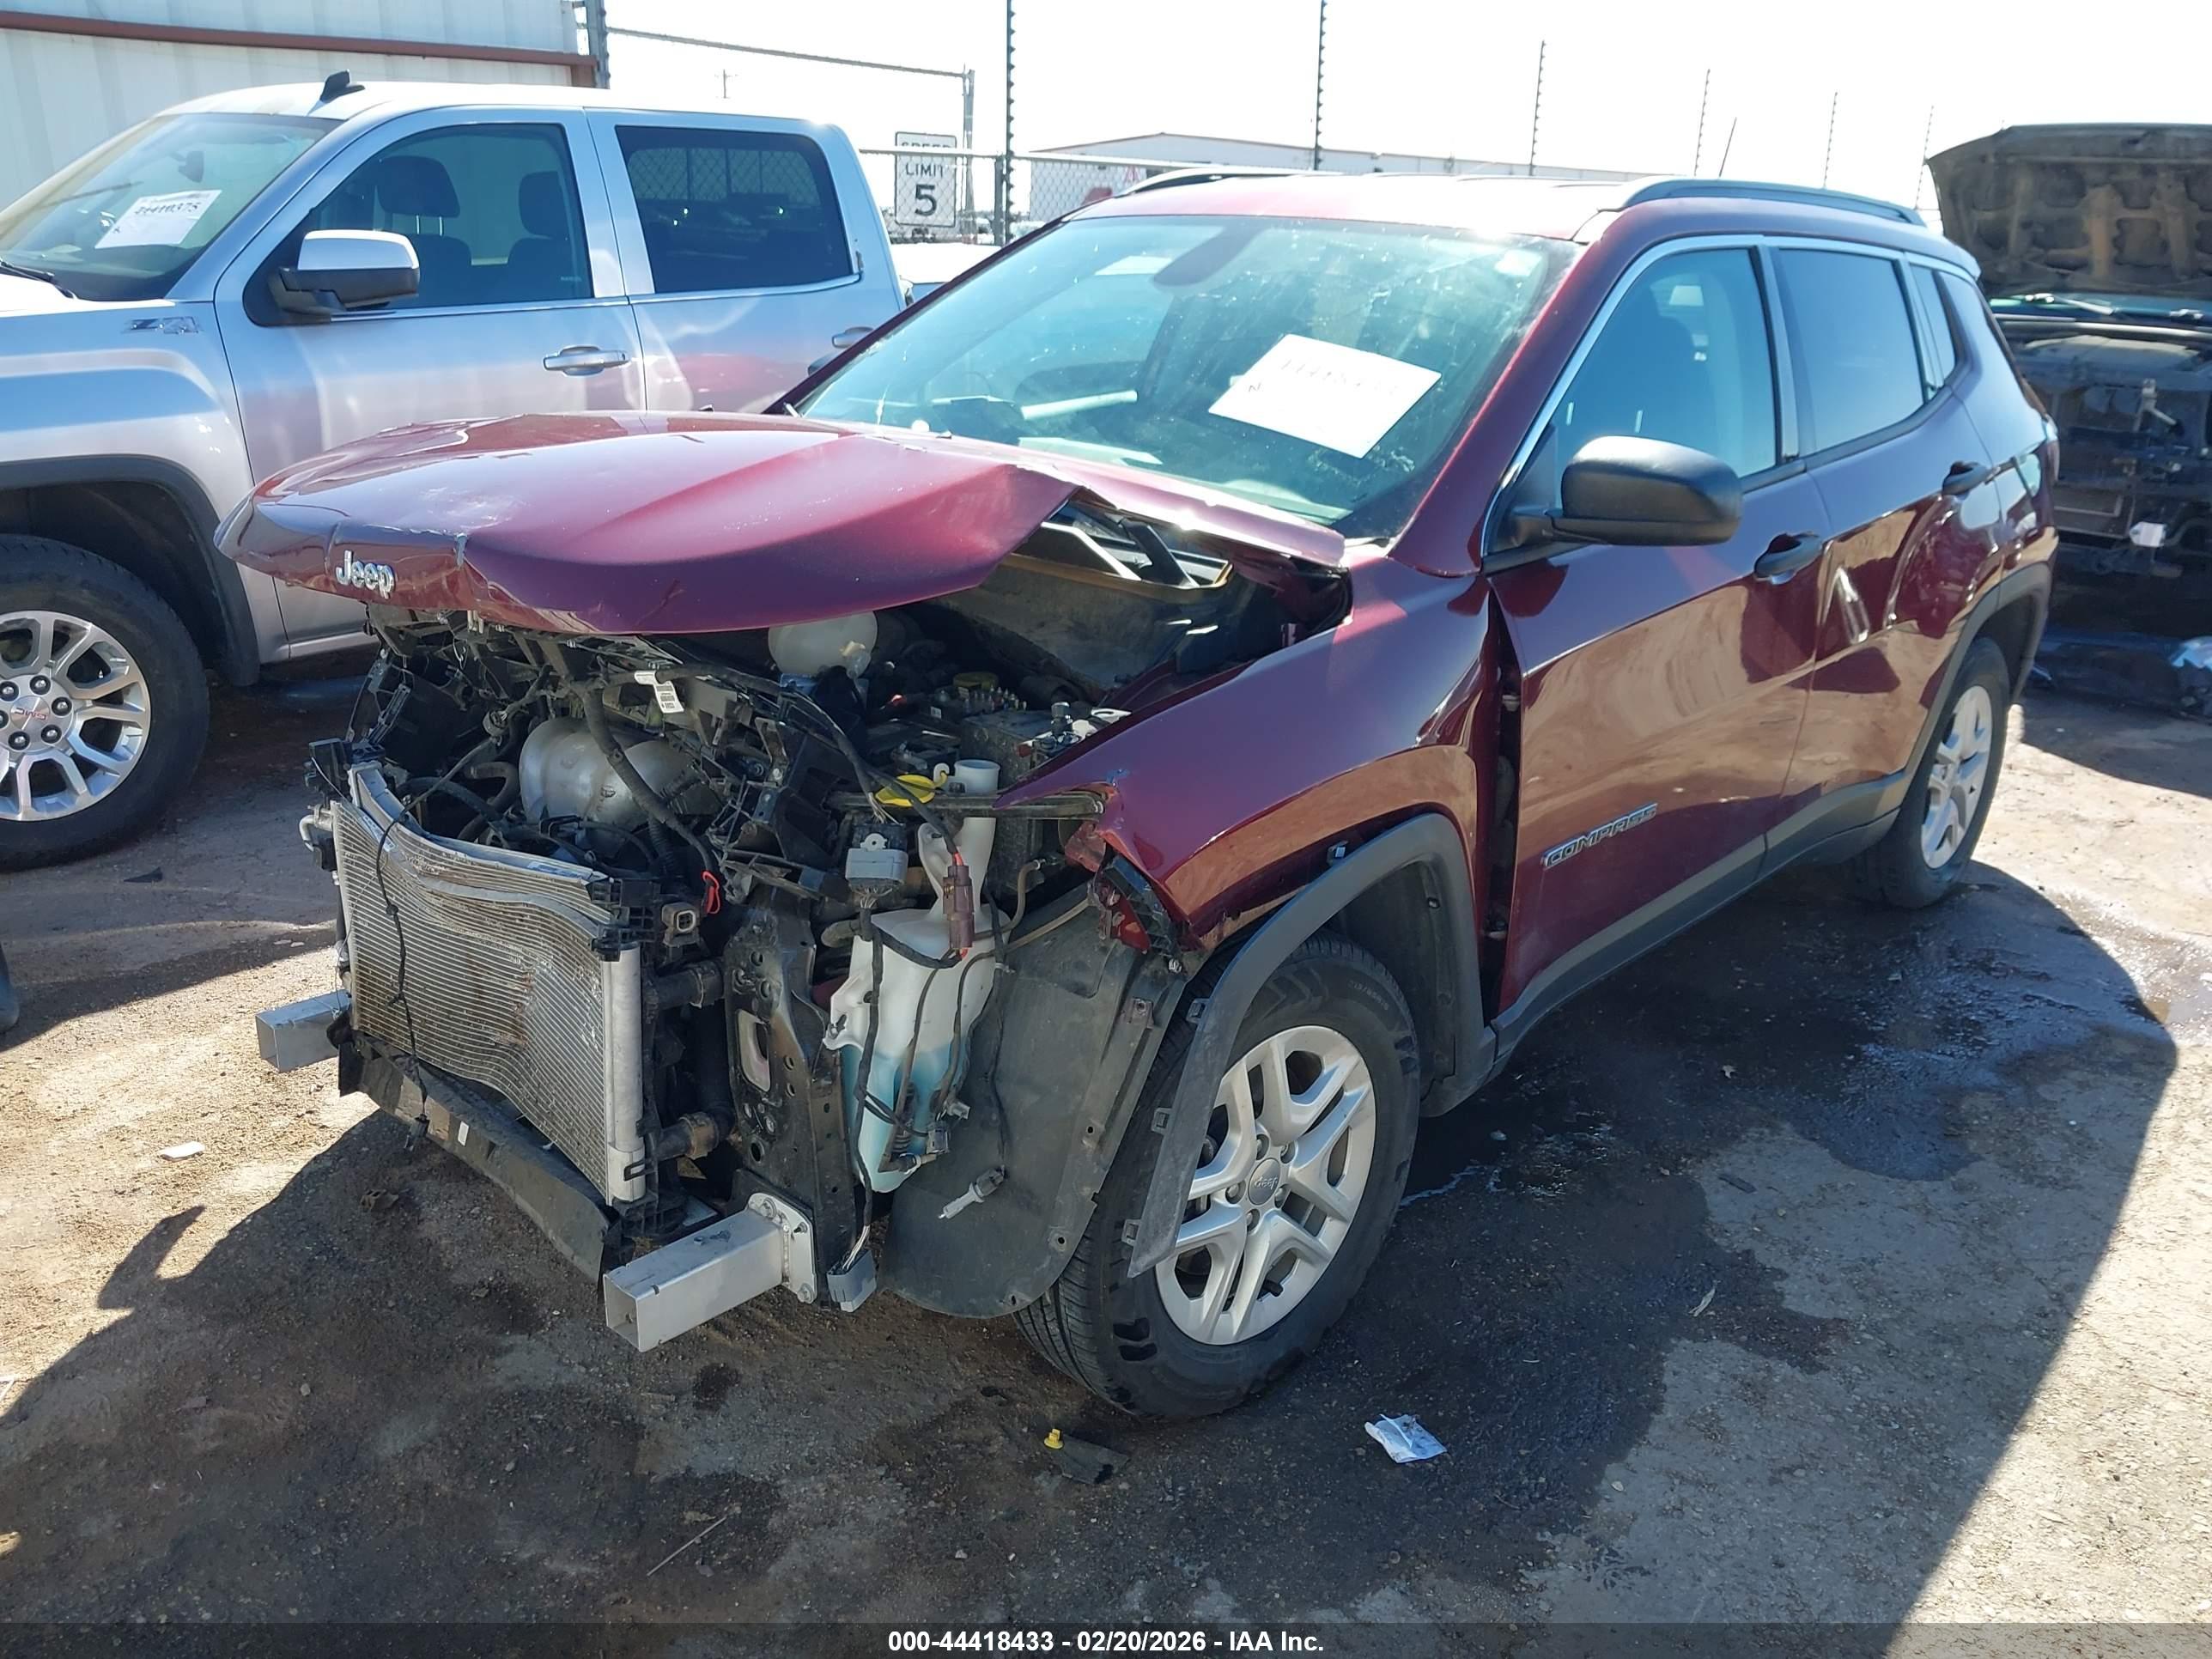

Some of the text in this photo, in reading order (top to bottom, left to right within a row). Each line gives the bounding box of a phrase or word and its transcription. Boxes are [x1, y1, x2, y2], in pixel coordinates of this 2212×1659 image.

[915, 184, 938, 216] 5
[336, 550, 396, 599] Jeep
[15, 707, 47, 720] GMC
[1542, 802, 1658, 870] COMPASS
